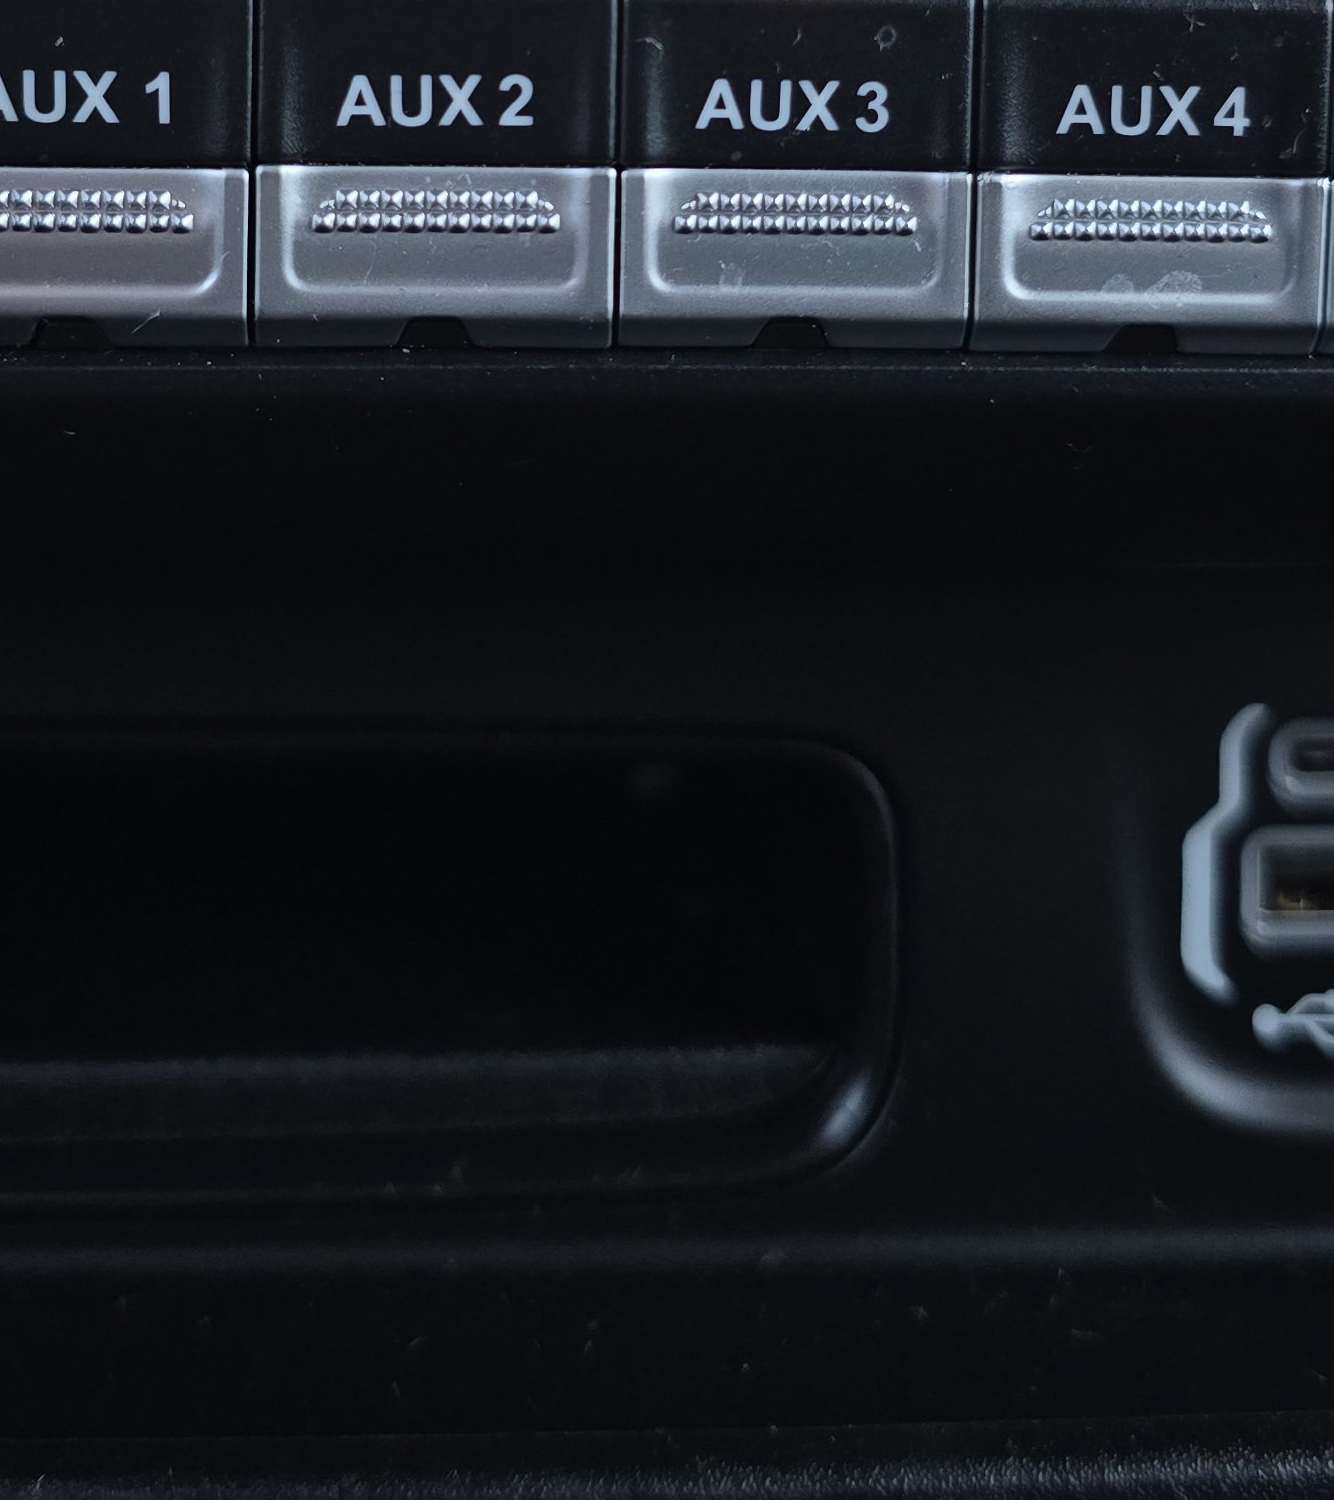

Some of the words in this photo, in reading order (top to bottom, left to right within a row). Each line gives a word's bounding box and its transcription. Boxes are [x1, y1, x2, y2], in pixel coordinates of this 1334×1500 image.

[146, 72, 170, 123] 1
[337, 75, 483, 126] AUX
[499, 74, 533, 125] 2
[696, 79, 839, 130] AUX
[856, 82, 888, 132] 3
[1056, 85, 1200, 135] AUX
[1214, 87, 1250, 136] 4
